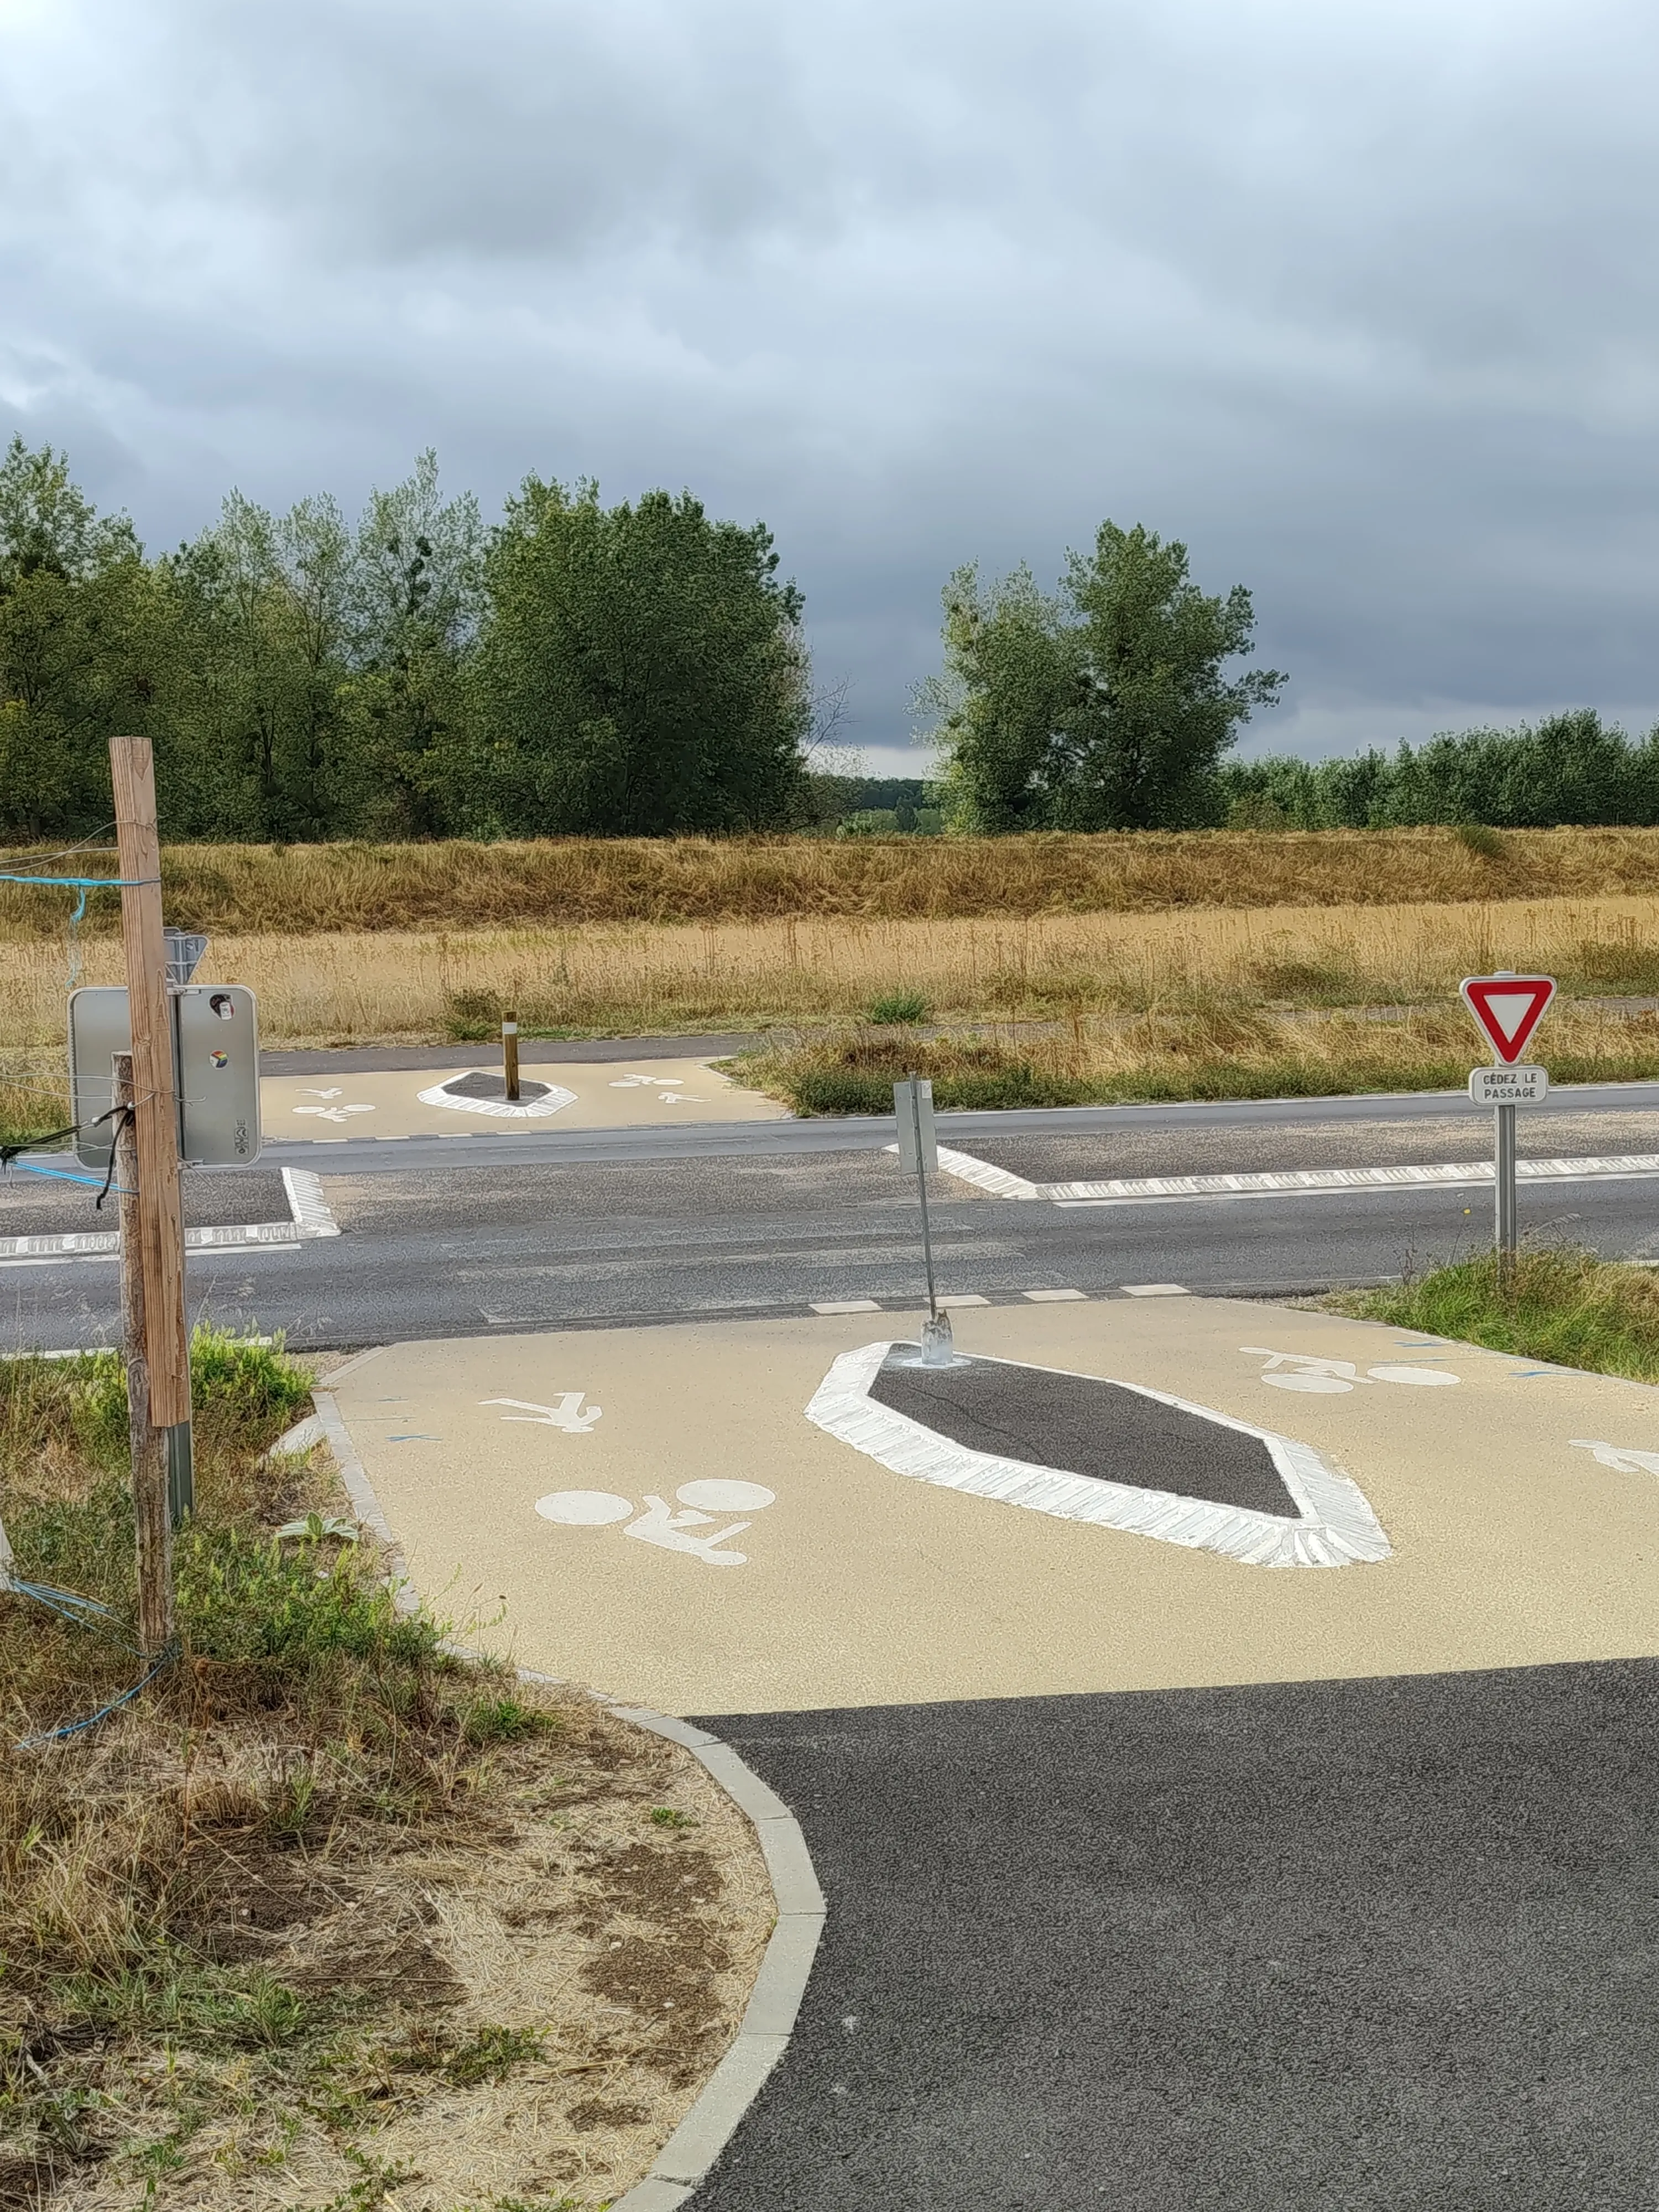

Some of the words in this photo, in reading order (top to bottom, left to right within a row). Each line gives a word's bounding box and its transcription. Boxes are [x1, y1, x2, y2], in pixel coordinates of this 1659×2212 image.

[1483, 1072, 1517, 1084] CÉDEZ
[1525, 1073, 1537, 1084] LE
[1484, 1087, 1536, 1099] PASSAGE
